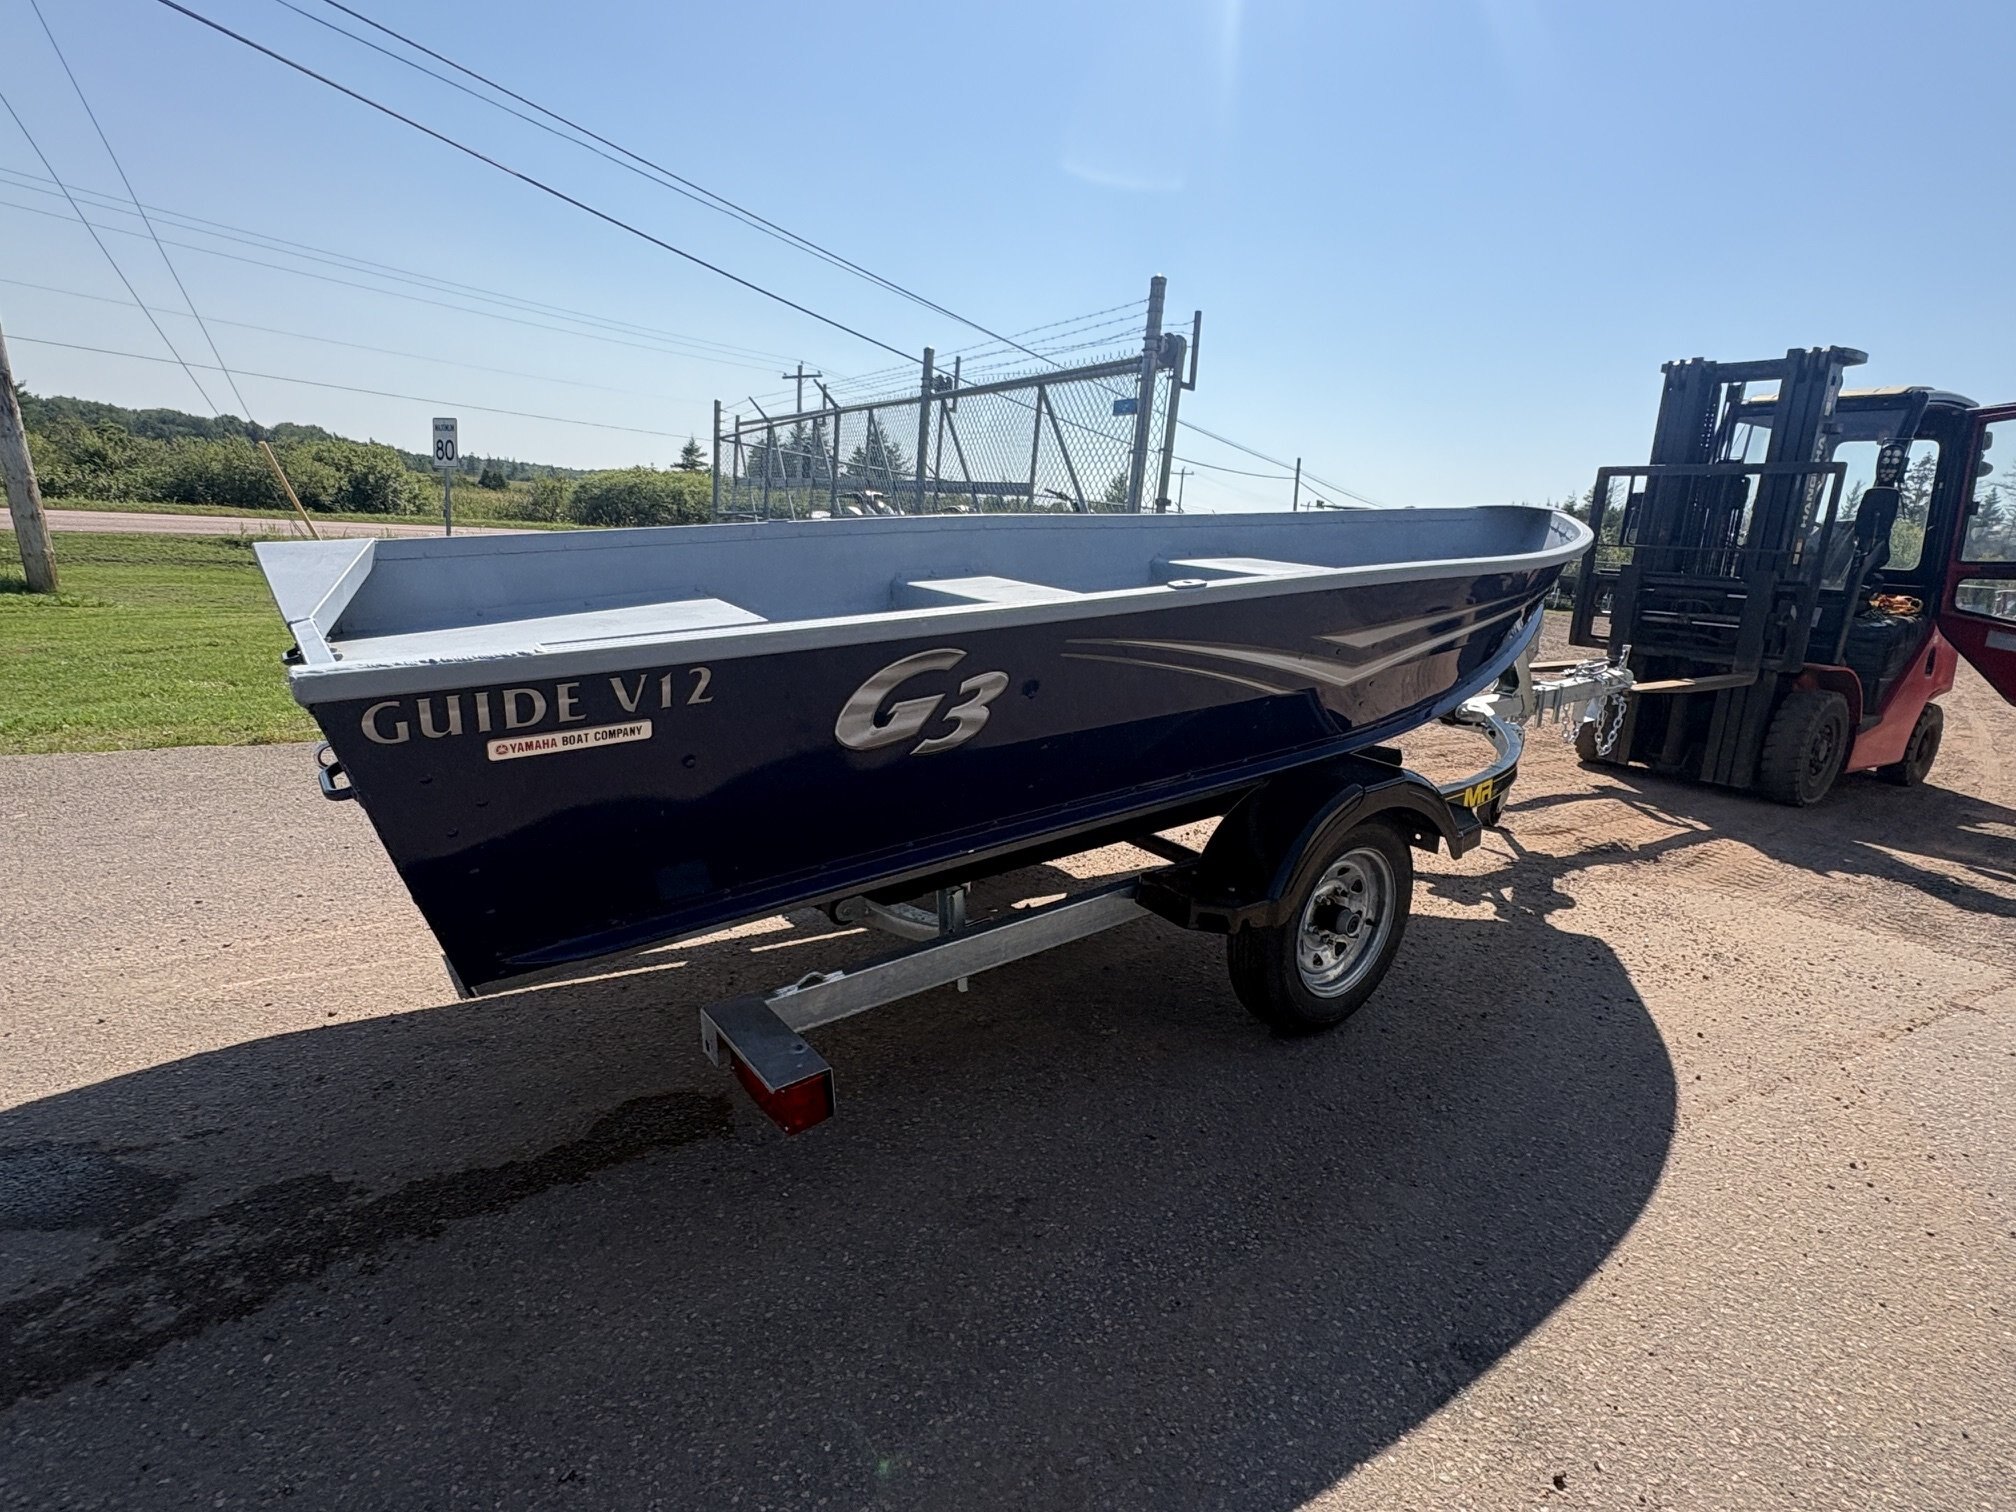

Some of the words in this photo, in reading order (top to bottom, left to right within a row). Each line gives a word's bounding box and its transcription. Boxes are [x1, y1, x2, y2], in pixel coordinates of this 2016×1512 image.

[436, 439, 455, 461] 80
[1800, 436, 1827, 529] HANGHA
[360, 681, 587, 745] GUIDE
[608, 666, 714, 713] V12
[510, 737, 558, 754] YAMAHA
[561, 732, 590, 746] BOAT
[594, 725, 643, 741] COMPANY
[834, 647, 1011, 756] G3
